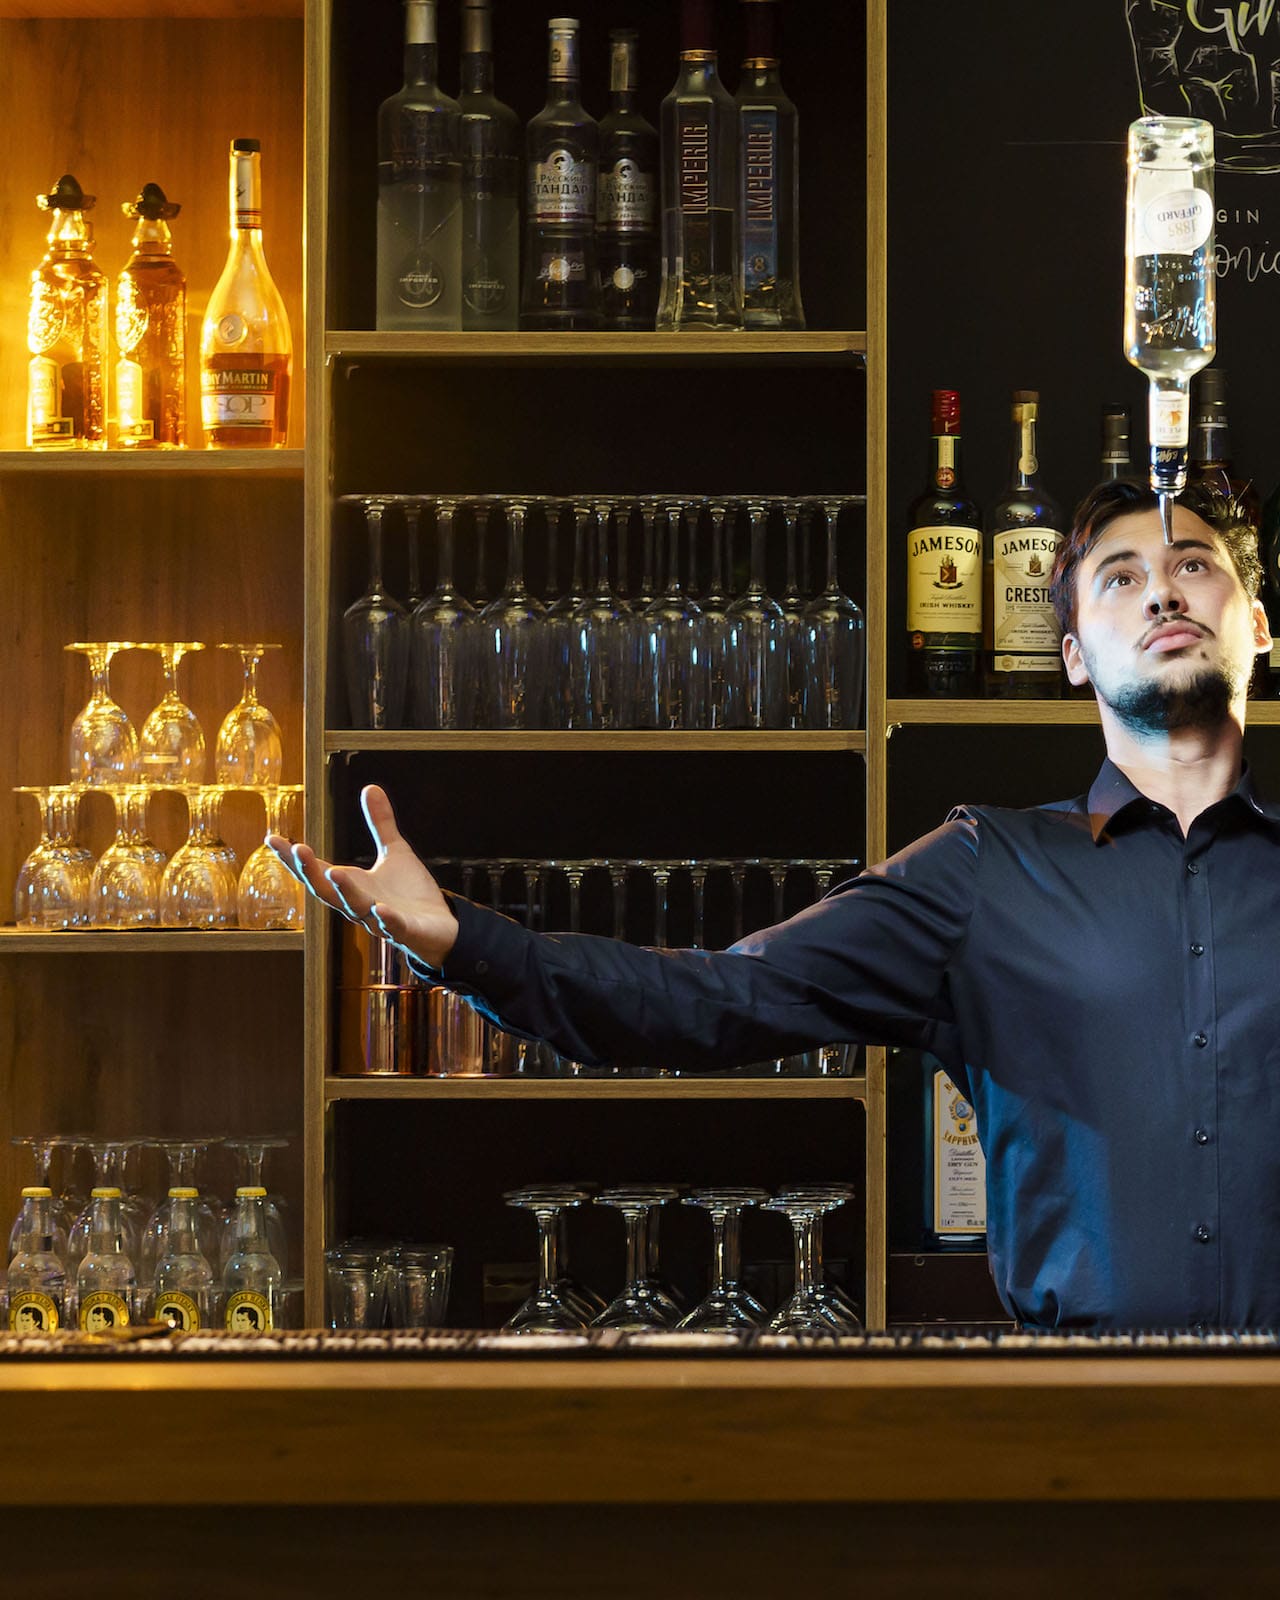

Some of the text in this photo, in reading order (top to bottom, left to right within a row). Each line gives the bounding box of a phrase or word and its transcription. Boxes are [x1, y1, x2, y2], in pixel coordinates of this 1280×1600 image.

[1157, 204, 1203, 222] GIFFARD
[1216, 208, 1261, 224] GIN
[754, 256, 765, 272] 8
[222, 370, 268, 385] MARTIN
[912, 536, 981, 557] JAMESON
[1001, 538, 1056, 556] JAMESO
[1006, 587, 1056, 603] CREST
[943, 1130, 978, 1146] SAPPHIR
